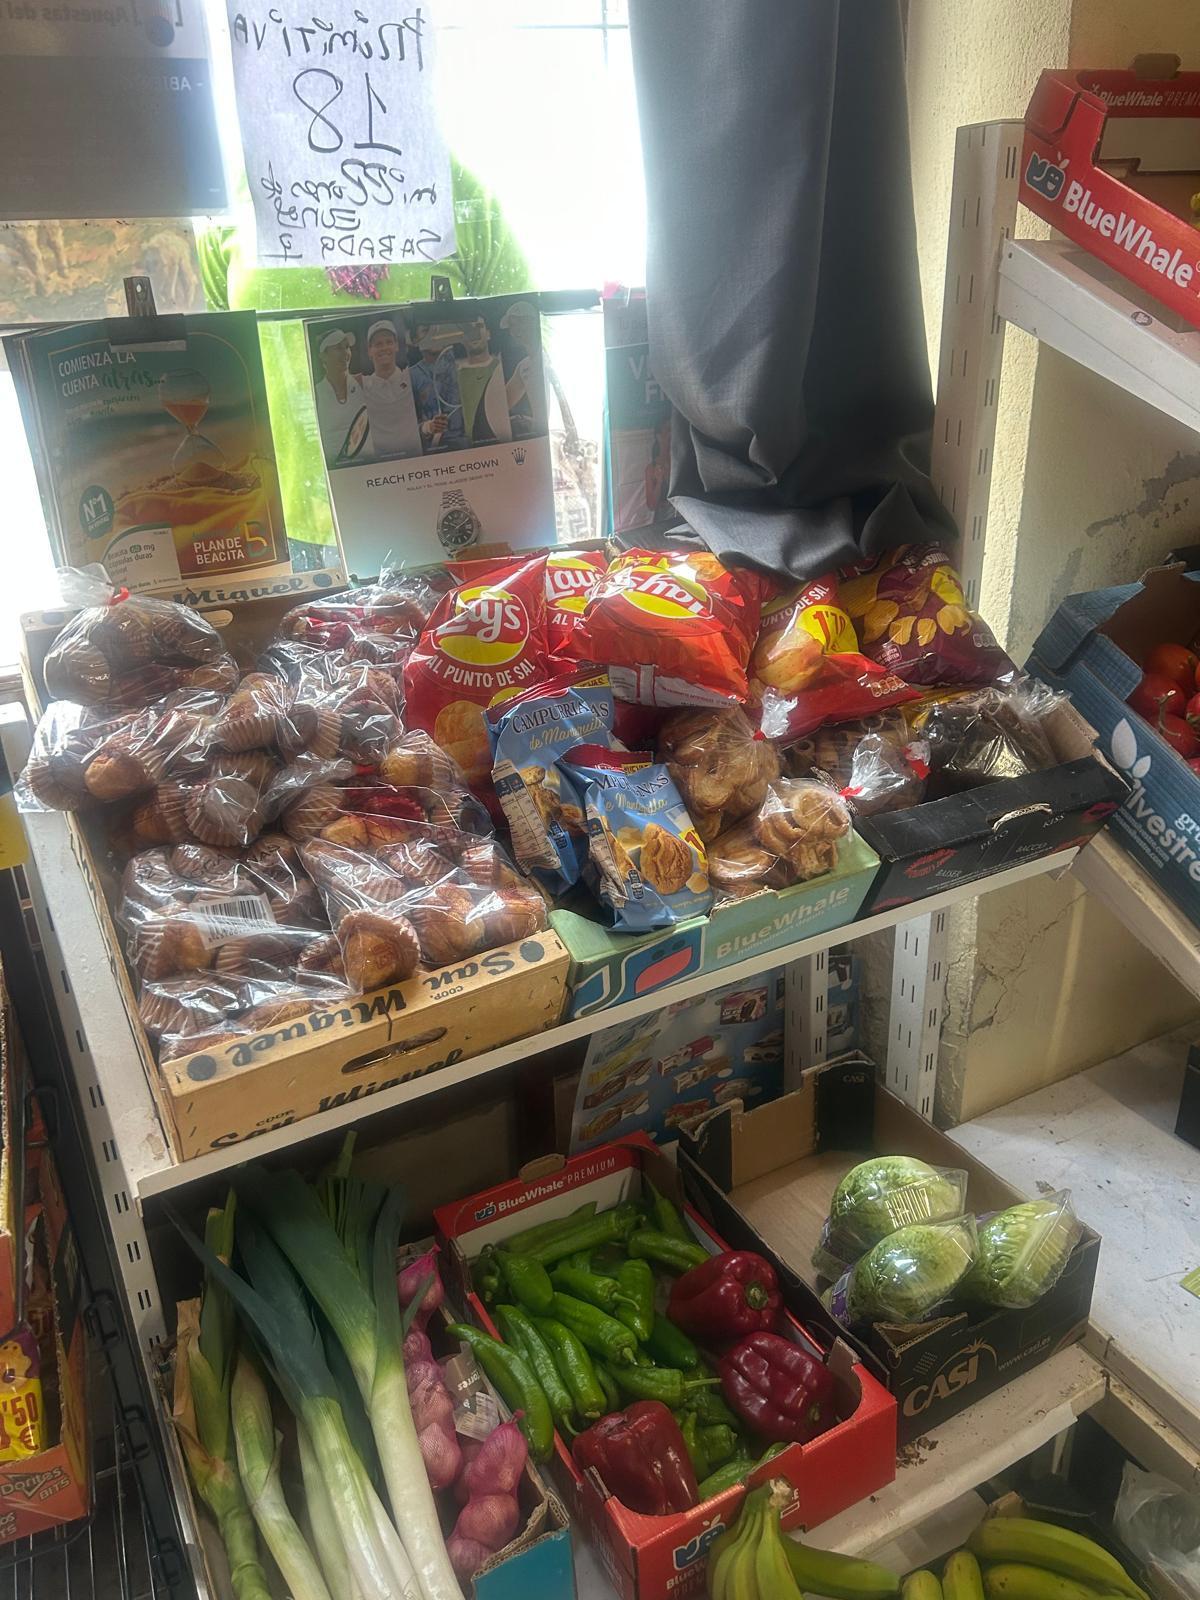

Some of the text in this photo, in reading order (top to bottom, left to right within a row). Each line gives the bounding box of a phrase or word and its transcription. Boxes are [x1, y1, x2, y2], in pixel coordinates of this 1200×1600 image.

[1165, 91, 1200, 107] PREMI
[1063, 180, 1193, 289] BlueWhale
[58, 351, 137, 377] COMIENZA LA
[62, 374, 100, 397] CUENTA
[366, 474, 406, 488] REACH
[408, 470, 431, 481] FOR
[433, 465, 457, 478] THE
[459, 458, 500, 473] CROWN
[193, 537, 242, 555] PLAN DE
[196, 550, 246, 566] BEACITA
[552, 613, 569, 626] AL
[762, 607, 793, 628] UNTO
[809, 584, 830, 601] SAL
[425, 655, 536, 688] AL PUNTO DE SAL
[716, 887, 850, 960] BlueWhale
[225, 951, 516, 1068] San Miguel
[498, 1157, 616, 1212] BlueWhale PREMIUM
[903, 1354, 979, 1417] CASI
[1, 1465, 63, 1496] Doritos
[39, 1476, 72, 1501] BITS
